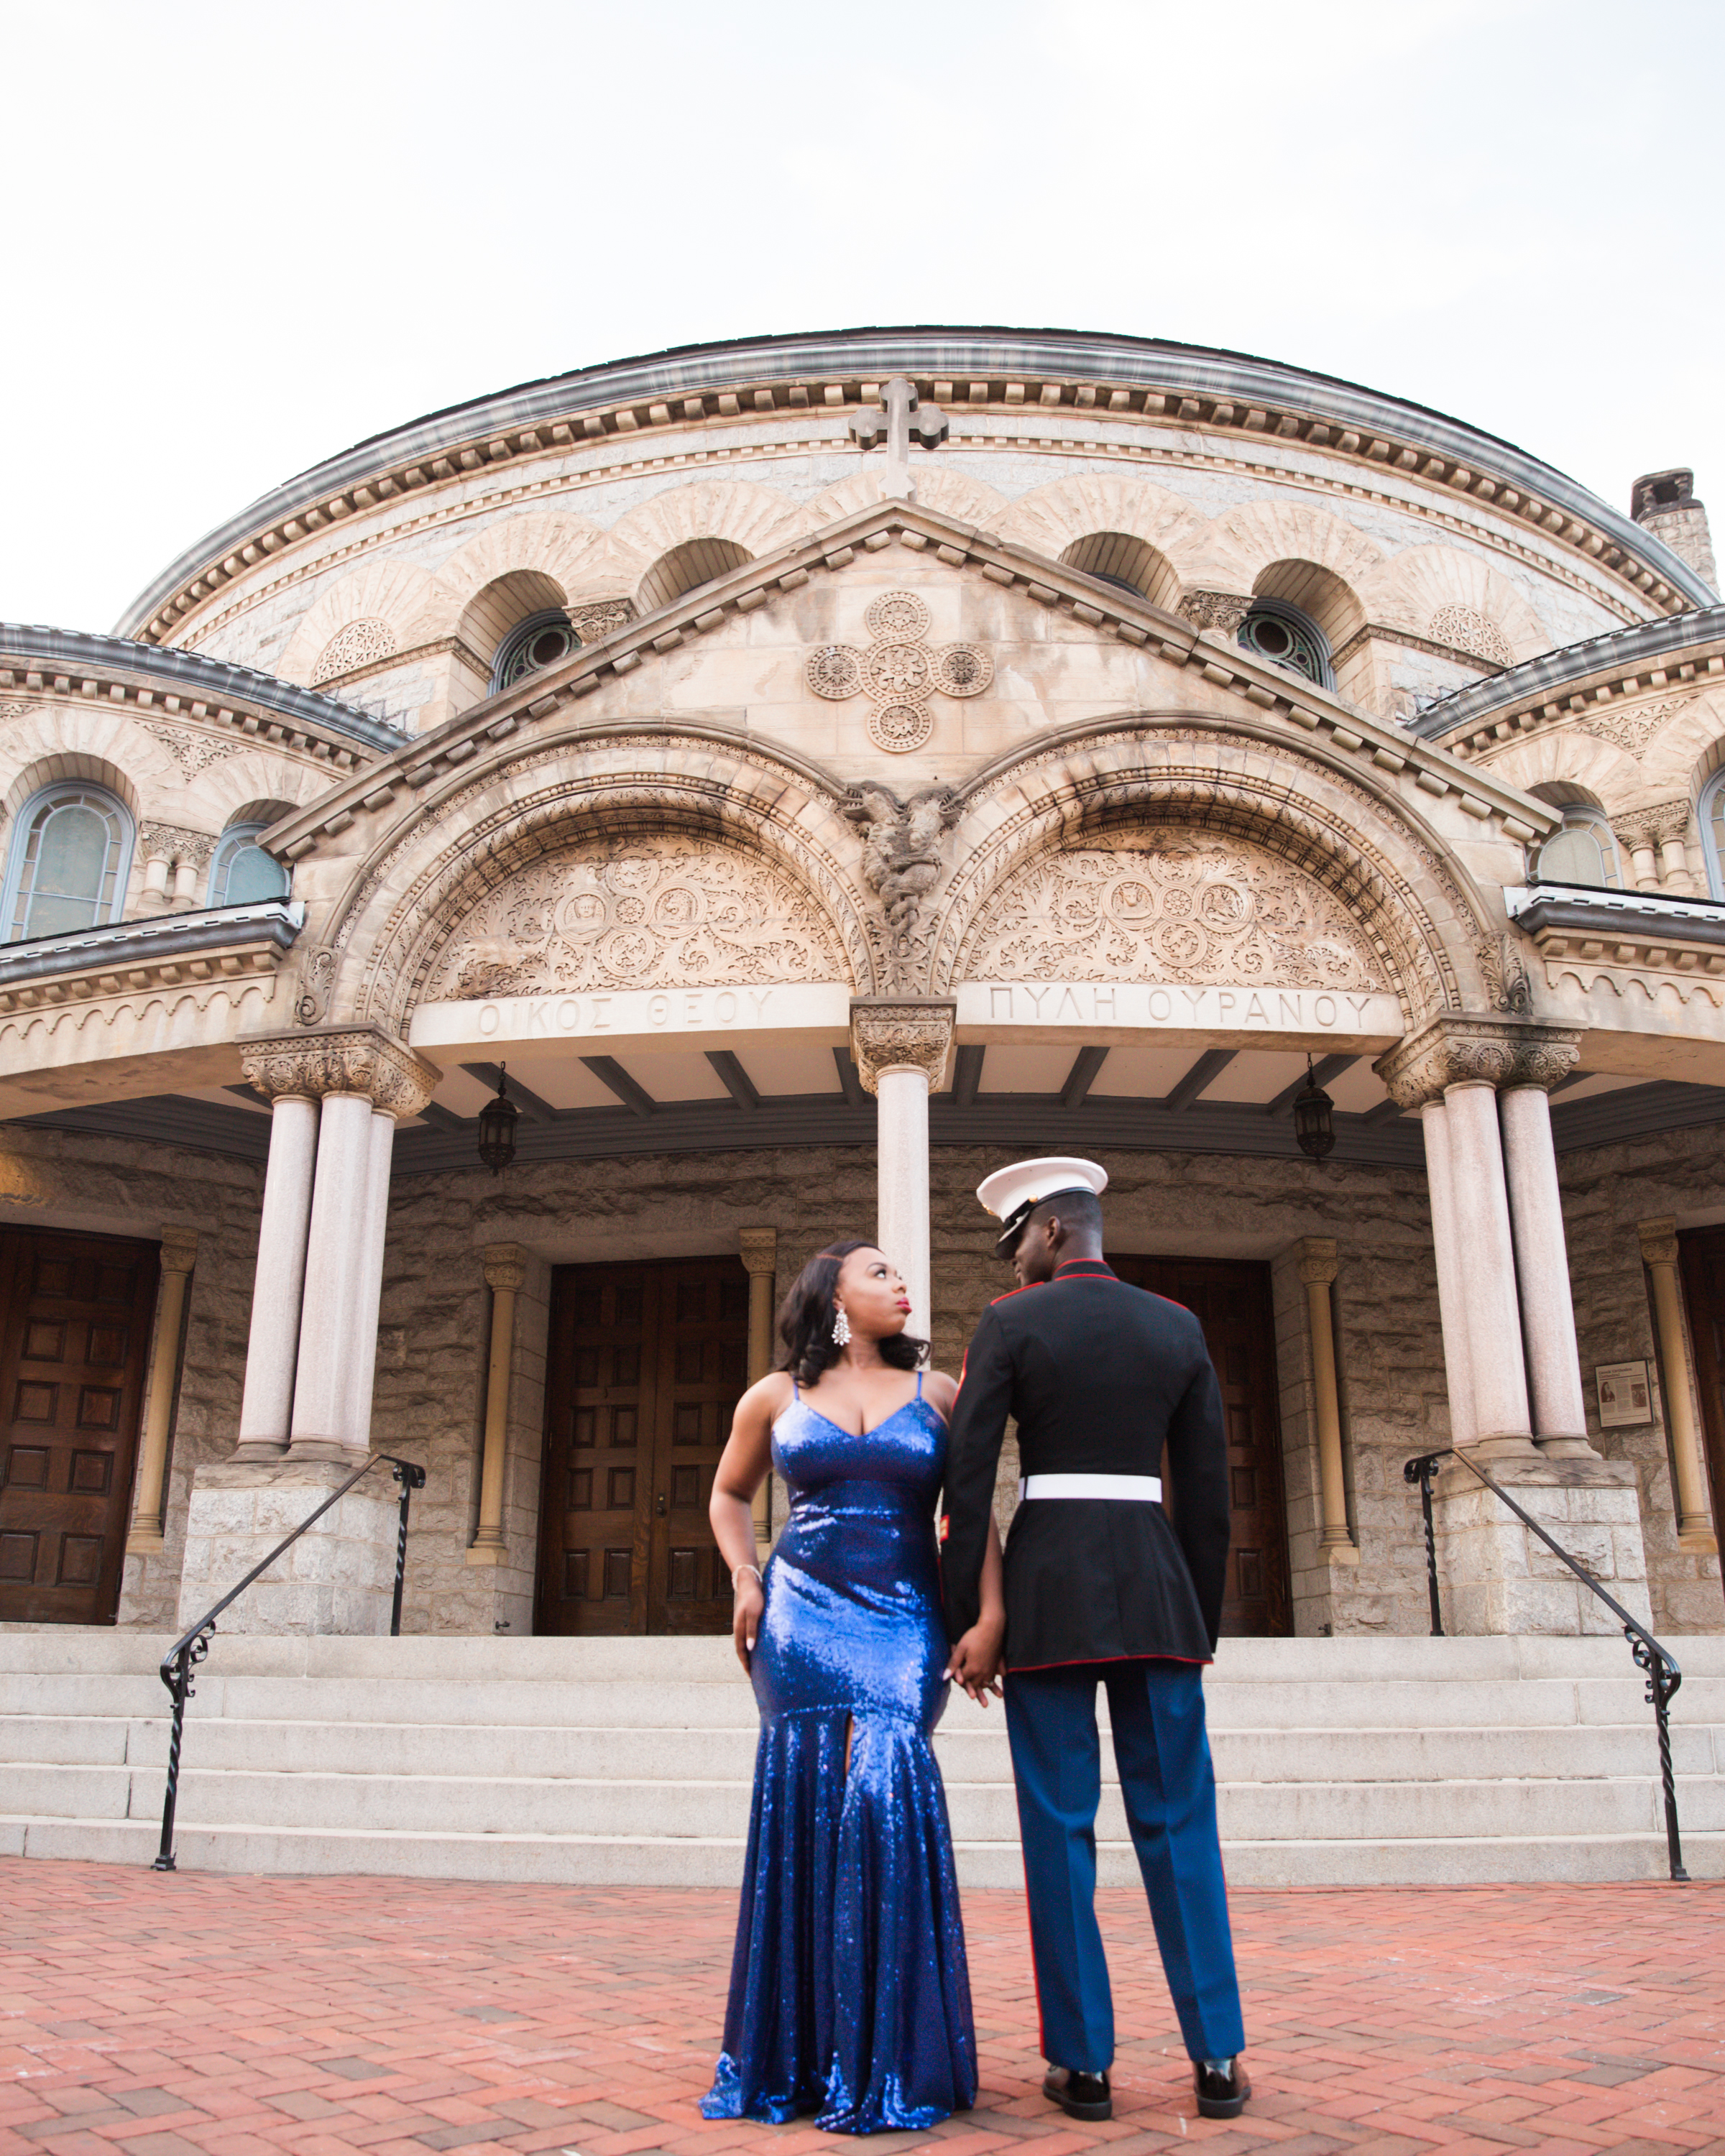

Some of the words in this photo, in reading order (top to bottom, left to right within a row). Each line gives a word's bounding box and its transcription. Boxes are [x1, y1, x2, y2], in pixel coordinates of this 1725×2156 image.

[477, 997, 612, 1036] ΟΙΚΟΣ
[646, 990, 774, 1028] ΘΕΟΥ
[989, 986, 1117, 1021] ΠΥΛΗ
[1148, 988, 1371, 1028] ΟΥΡΑΝΟΥ
